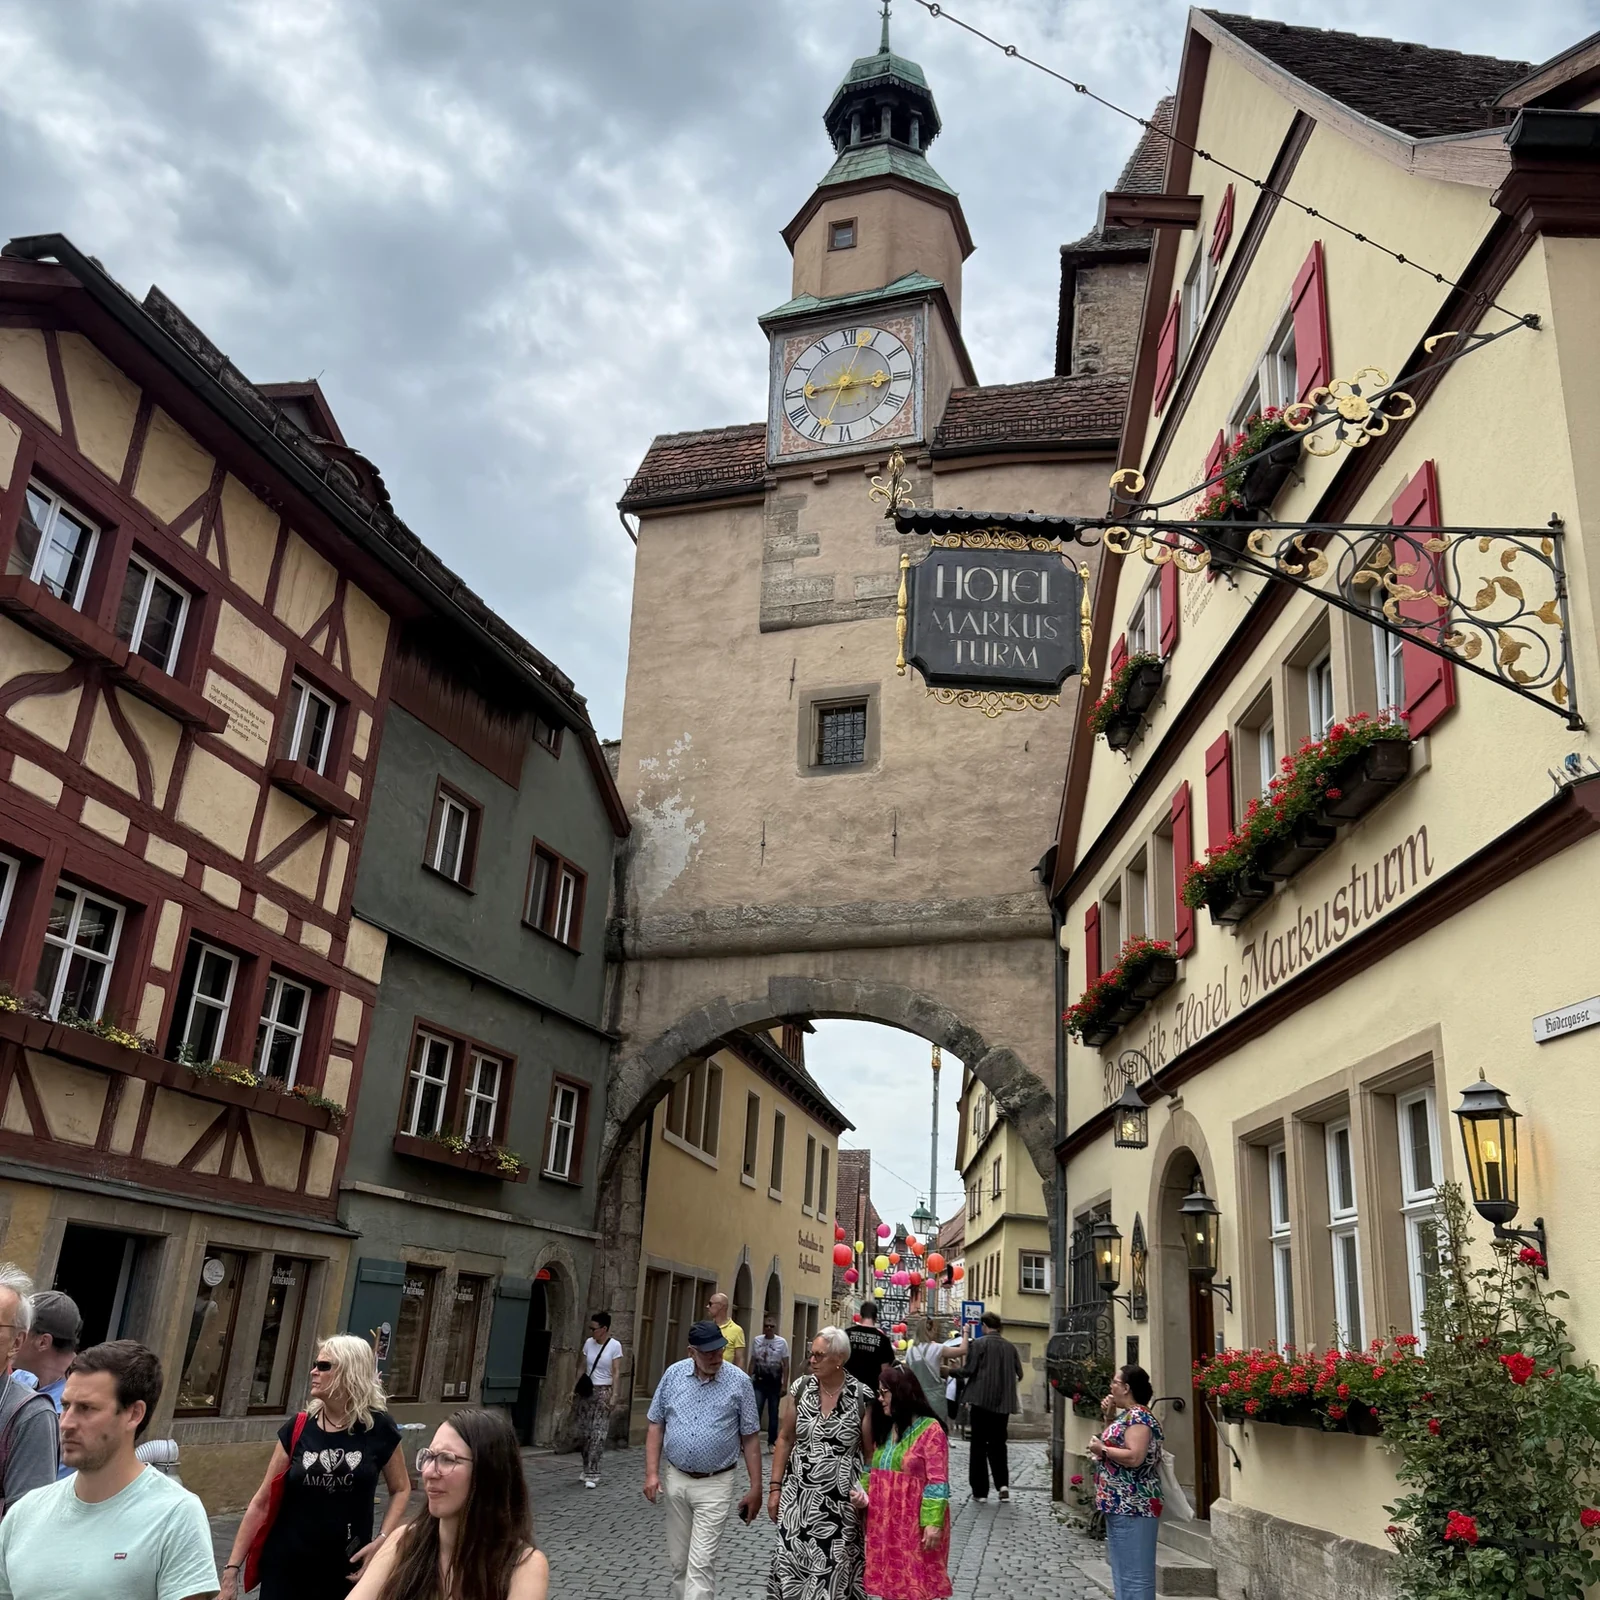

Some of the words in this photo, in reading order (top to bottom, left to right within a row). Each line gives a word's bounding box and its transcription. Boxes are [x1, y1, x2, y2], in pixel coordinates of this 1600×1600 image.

[841, 329, 857, 347] XII
[814, 340, 830, 357] XI
[886, 345, 904, 360] II
[794, 363, 811, 375] X
[893, 370, 911, 382] III
[869, 416, 884, 431] V
[936, 563, 1058, 604] HOTEL
[930, 609, 1058, 640] MARKUS
[950, 639, 1039, 669] TURM
[1173, 965, 1232, 1055] Hotel
[1239, 825, 1434, 1008] Markusturm
